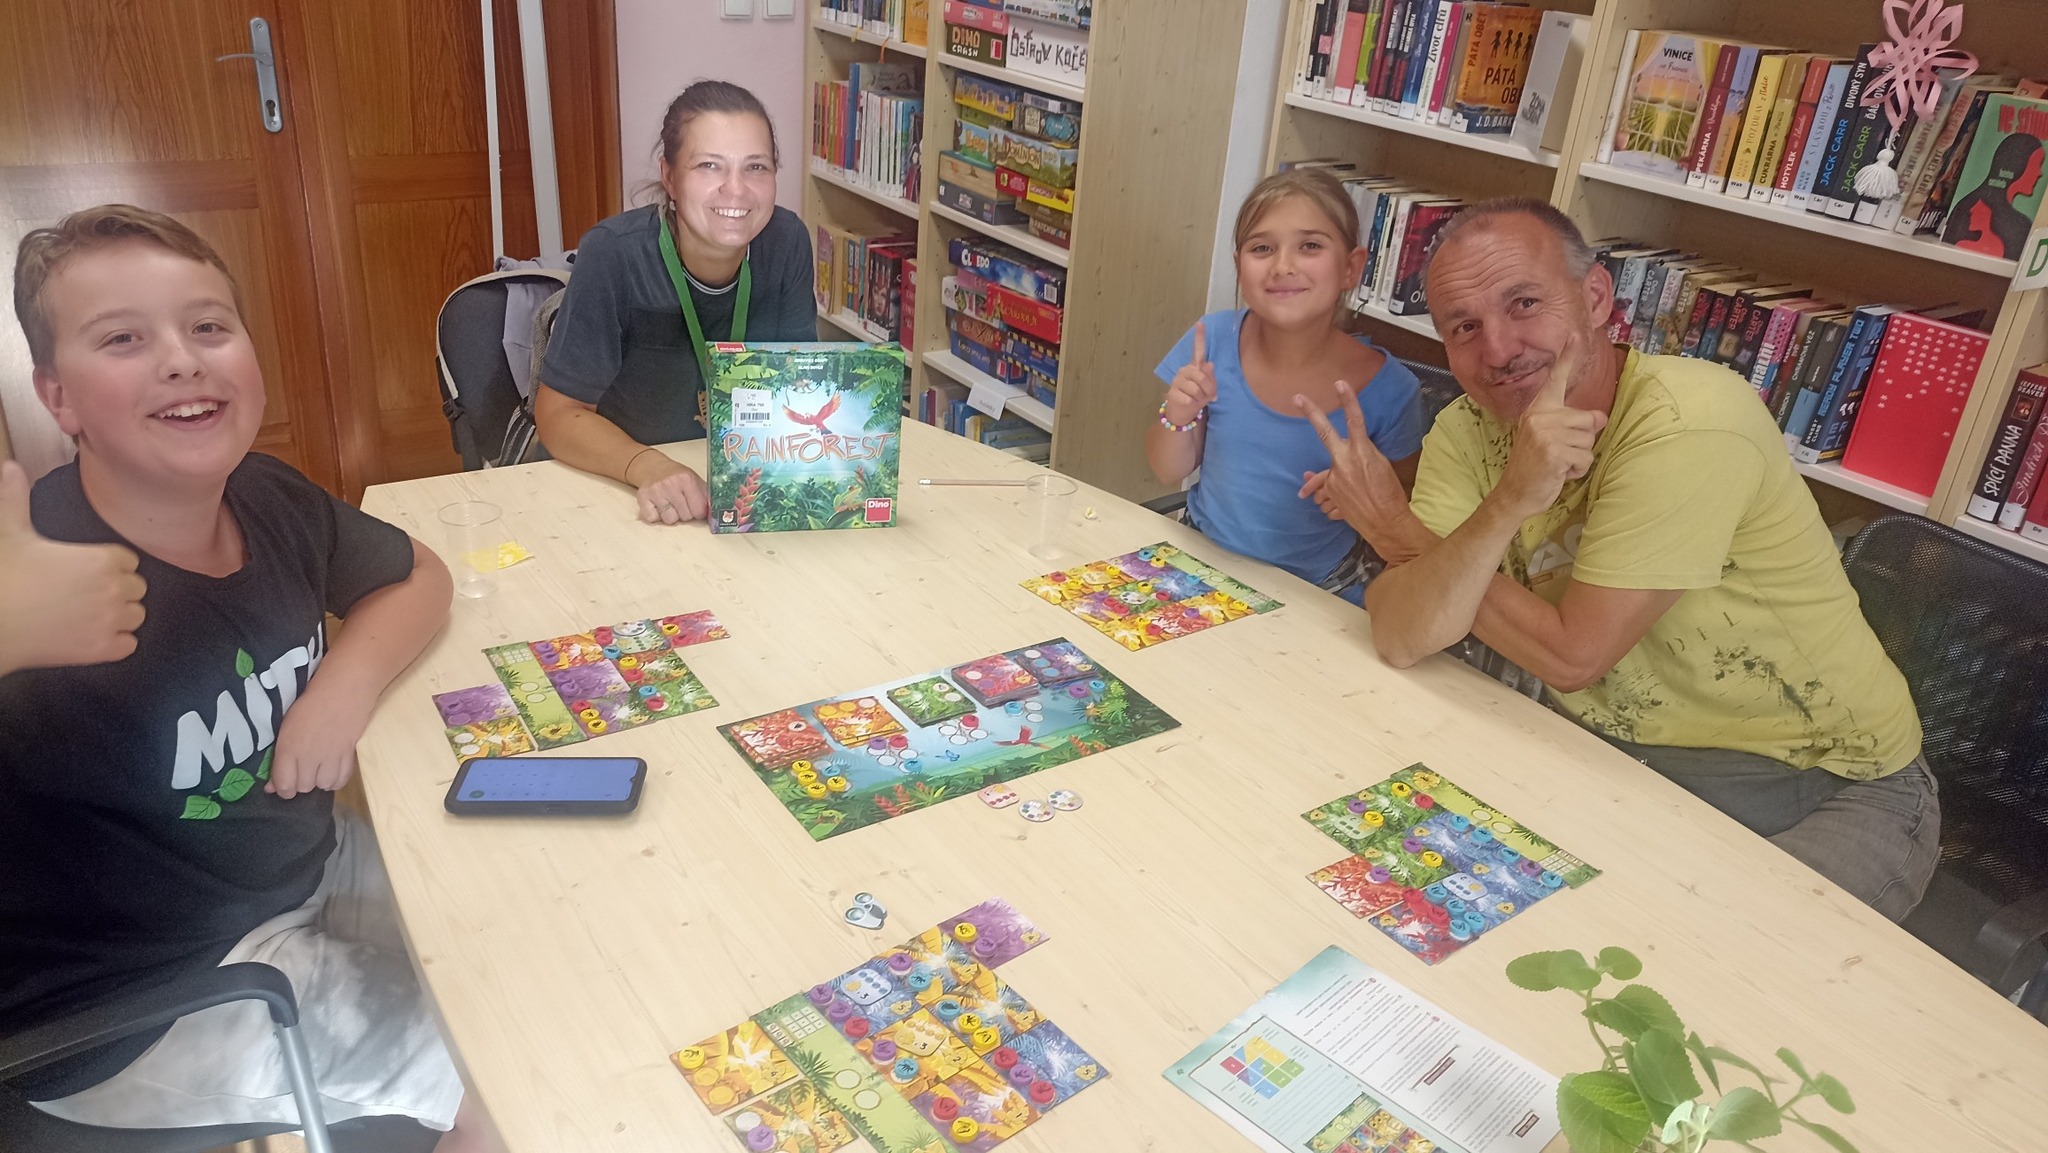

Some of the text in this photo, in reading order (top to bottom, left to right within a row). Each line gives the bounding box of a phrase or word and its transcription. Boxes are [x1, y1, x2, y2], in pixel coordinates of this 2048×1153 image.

[952, 26, 980, 48] DINO
[952, 45, 978, 57] CRASH
[1010, 28, 1088, 73] OSTROV KOČE
[1663, 47, 1693, 61] VINICE
[1484, 64, 1517, 85] PÁTÁ
[1502, 87, 1522, 104] OB
[1820, 62, 1868, 185] JACK CARR DIVOKÝ SYN
[1759, 139, 1777, 184] CUKRÁRNA
[1780, 151, 1797, 189] HOTÝLEK
[1840, 161, 1858, 192] JACK
[1853, 124, 1872, 158] CARR
[1916, 211, 1941, 229] JAME
[961, 249, 990, 269] CLUEDO
[1619, 262, 1633, 292] CARTER
[1641, 269, 1655, 301] CARTER
[1677, 280, 1692, 312] CARTER
[1728, 297, 1744, 330] CARTER
[1745, 310, 1761, 342] CARTER
[1817, 382, 1838, 417] READY
[1832, 342, 1856, 383] PLAYER
[1850, 319, 1865, 340] TWO
[723, 432, 897, 464] RAINFOREST
[1983, 424, 2023, 497] SPÍCÍ PANNA
[868, 500, 889, 509] Dino
